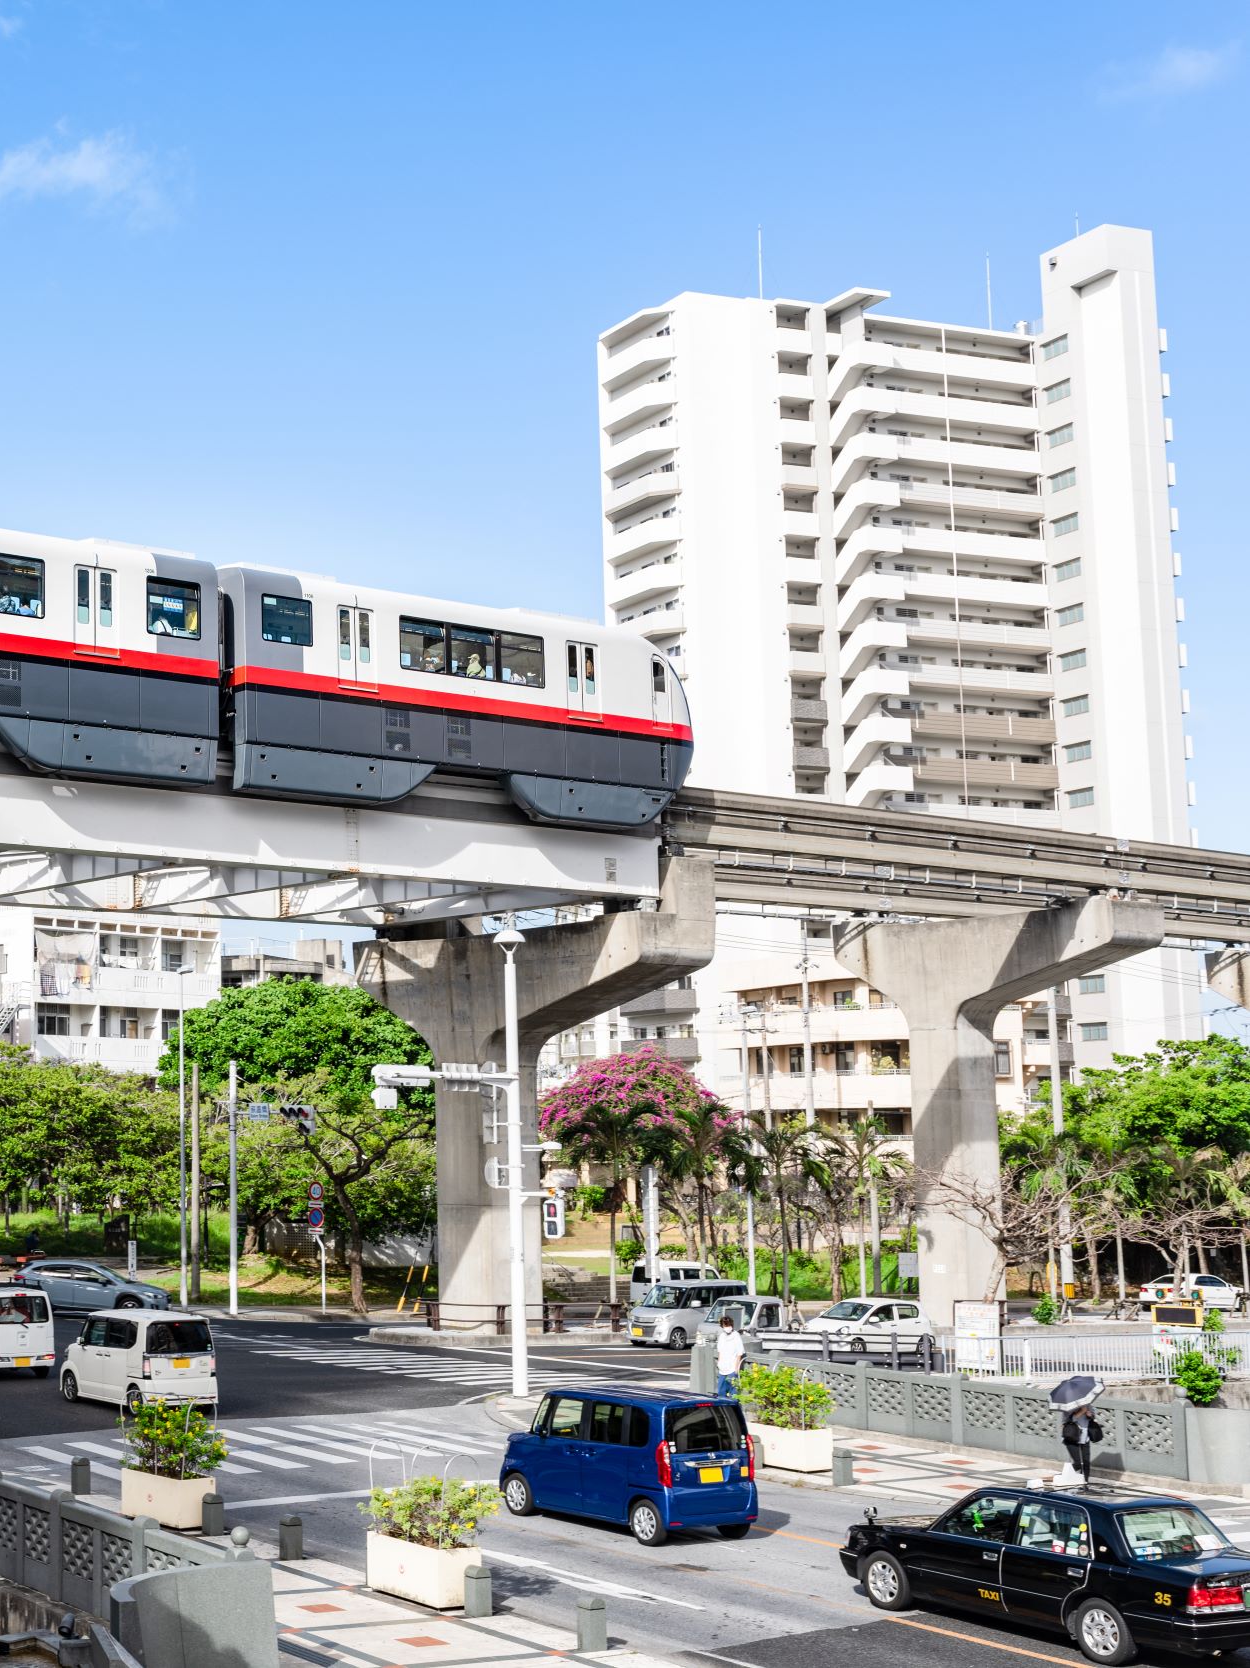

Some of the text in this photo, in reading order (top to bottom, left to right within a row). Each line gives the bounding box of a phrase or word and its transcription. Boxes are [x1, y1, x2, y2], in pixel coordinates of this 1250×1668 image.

[312, 1187, 320, 1196] 40
[978, 1588, 1000, 1601] TAXI
[1154, 1591, 1172, 1606] 35
